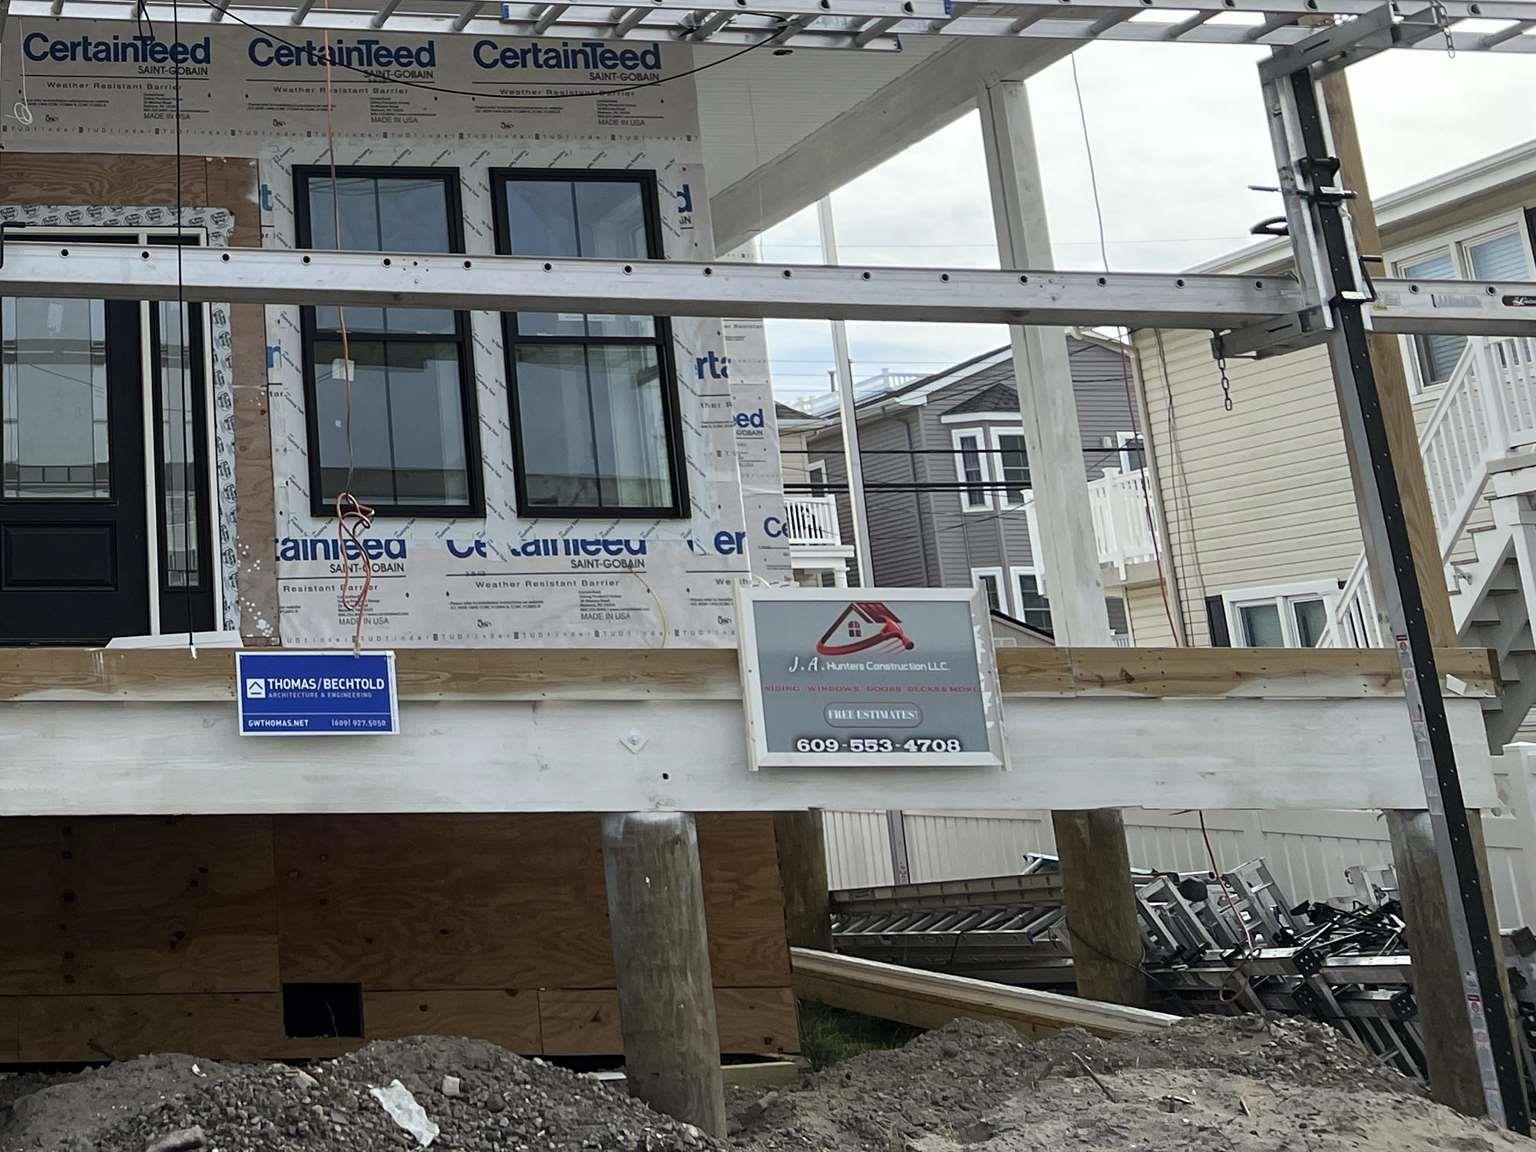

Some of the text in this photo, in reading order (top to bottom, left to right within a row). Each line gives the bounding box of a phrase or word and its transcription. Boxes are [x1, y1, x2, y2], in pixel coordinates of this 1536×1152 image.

[23, 32, 211, 64] CertainTeed
[249, 38, 435, 69] CertainTeed
[473, 40, 662, 70] CertainTeed
[138, 65, 208, 76] SAINT-GOBAIN
[364, 70, 433, 79] SAINT-GOBAIN
[589, 72, 660, 81] SAINT-GOBAIN
[571, 559, 646, 570] SAINT-GOBAIN
[476, 579, 619, 589] Weather Resistant Barrier
[827, 662, 865, 671] Hunters
[866, 662, 927, 671] Construction
[828, 710, 855, 720] FREE
